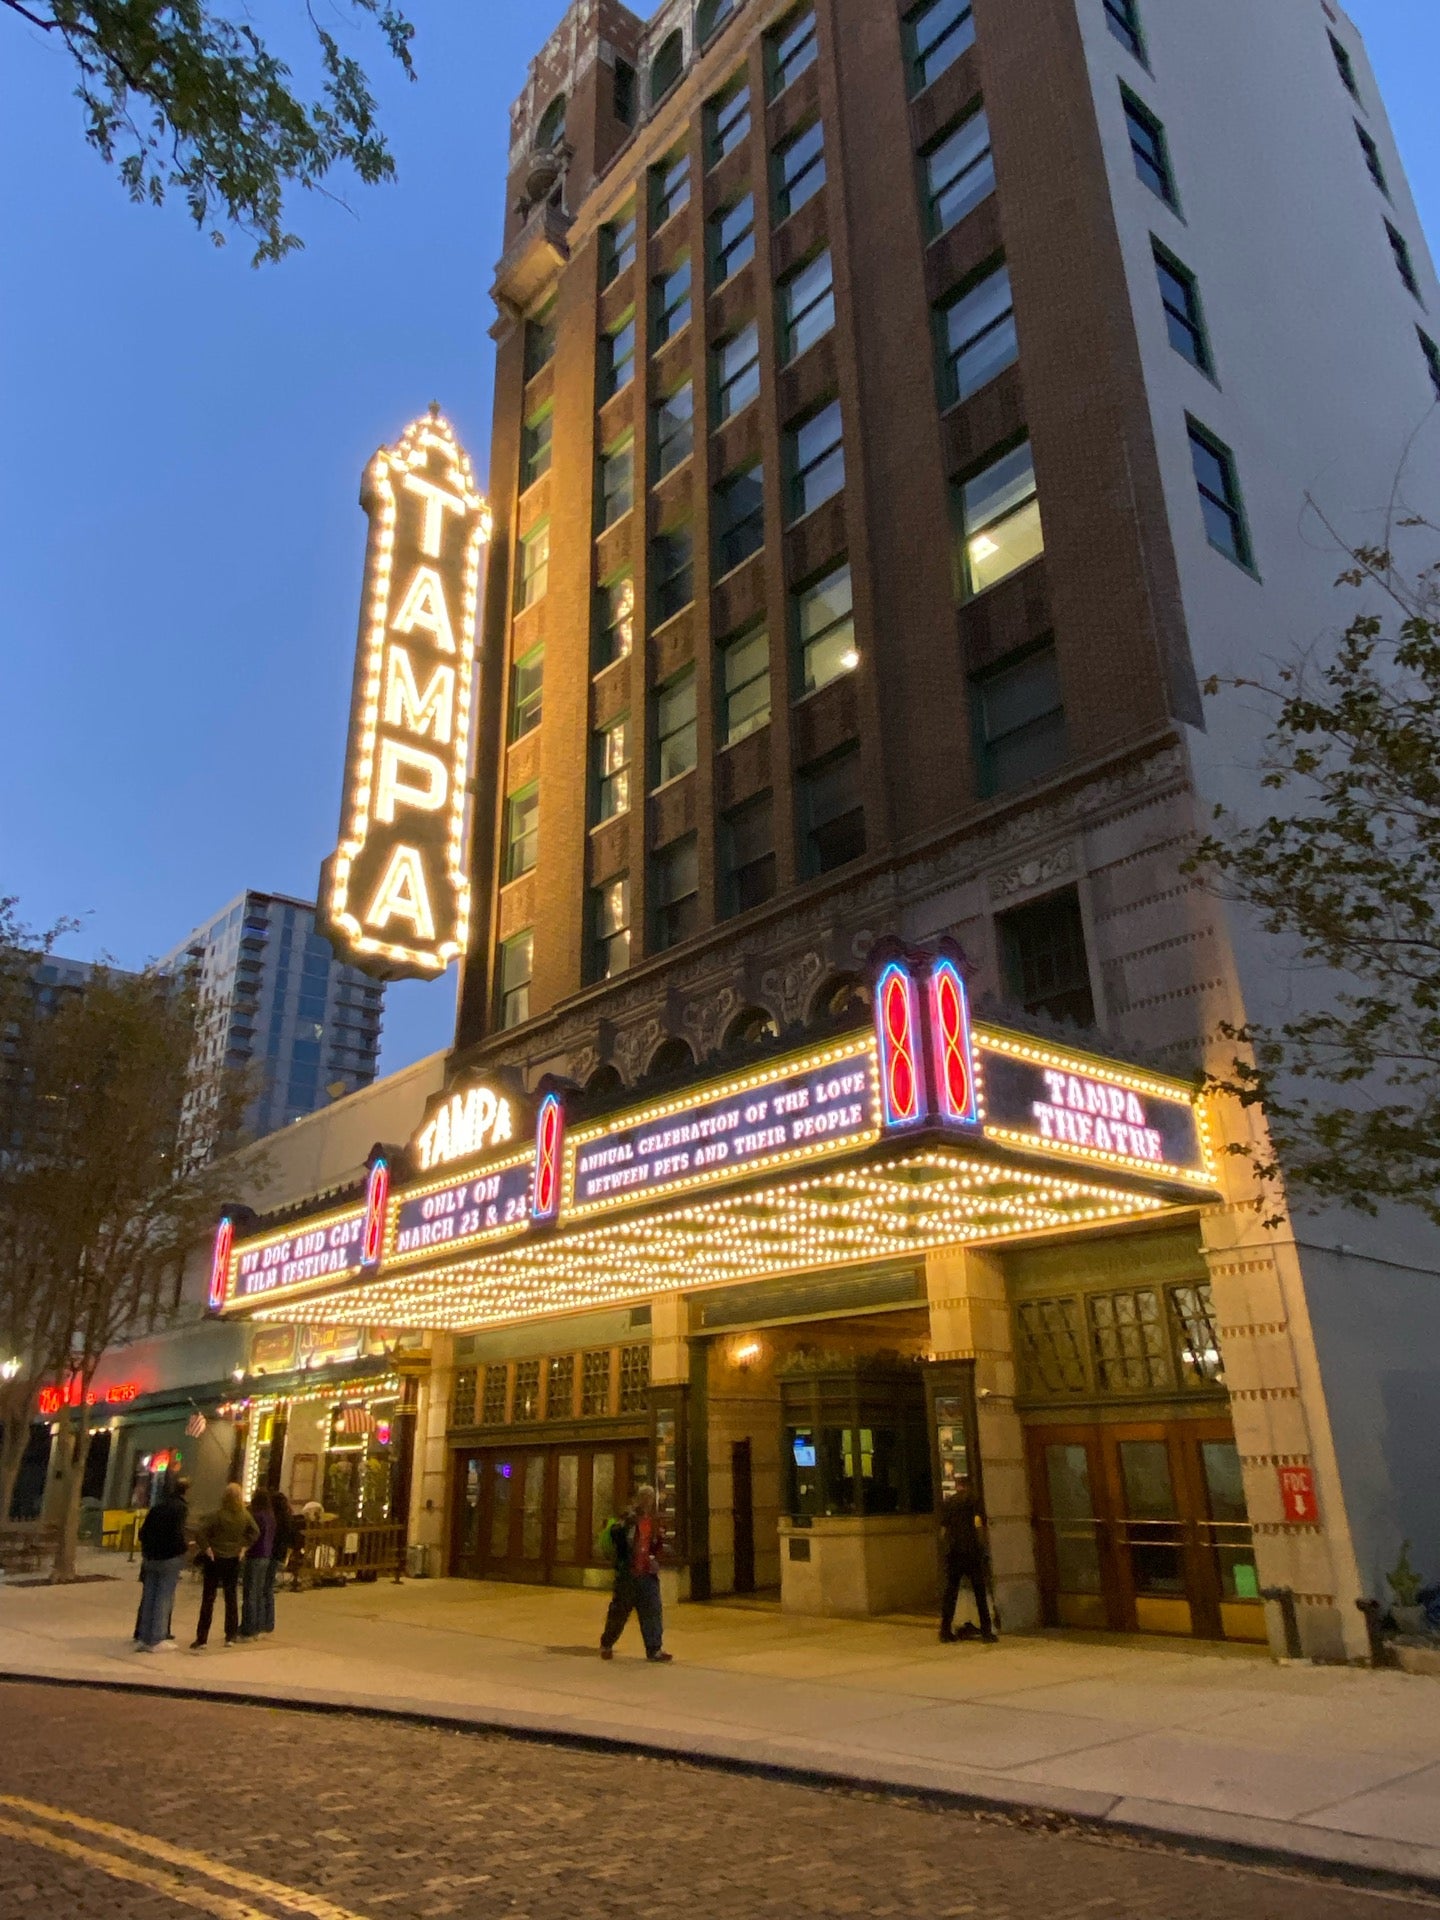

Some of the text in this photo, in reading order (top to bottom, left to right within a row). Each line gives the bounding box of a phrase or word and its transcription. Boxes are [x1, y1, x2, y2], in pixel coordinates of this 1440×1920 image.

[367, 472, 466, 940] TAMPA
[580, 1072, 865, 1172] ANNUAL CELEBRATION OF THE LOVE
[1044, 1069, 1146, 1125] TAMPA
[418, 1087, 513, 1171] TAMPA
[586, 1103, 862, 1196] BETWEEN PETS AND THEIR PEOPLE
[1032, 1101, 1164, 1160] THEATRE
[397, 1195, 526, 1252] MARCH 23 & 24
[422, 1176, 501, 1219] ONLY ON
[241, 1219, 362, 1274] MY DOG AND CAT
[246, 1247, 348, 1293] FILM FESTIVAL
[1283, 1472, 1309, 1492] FDC
